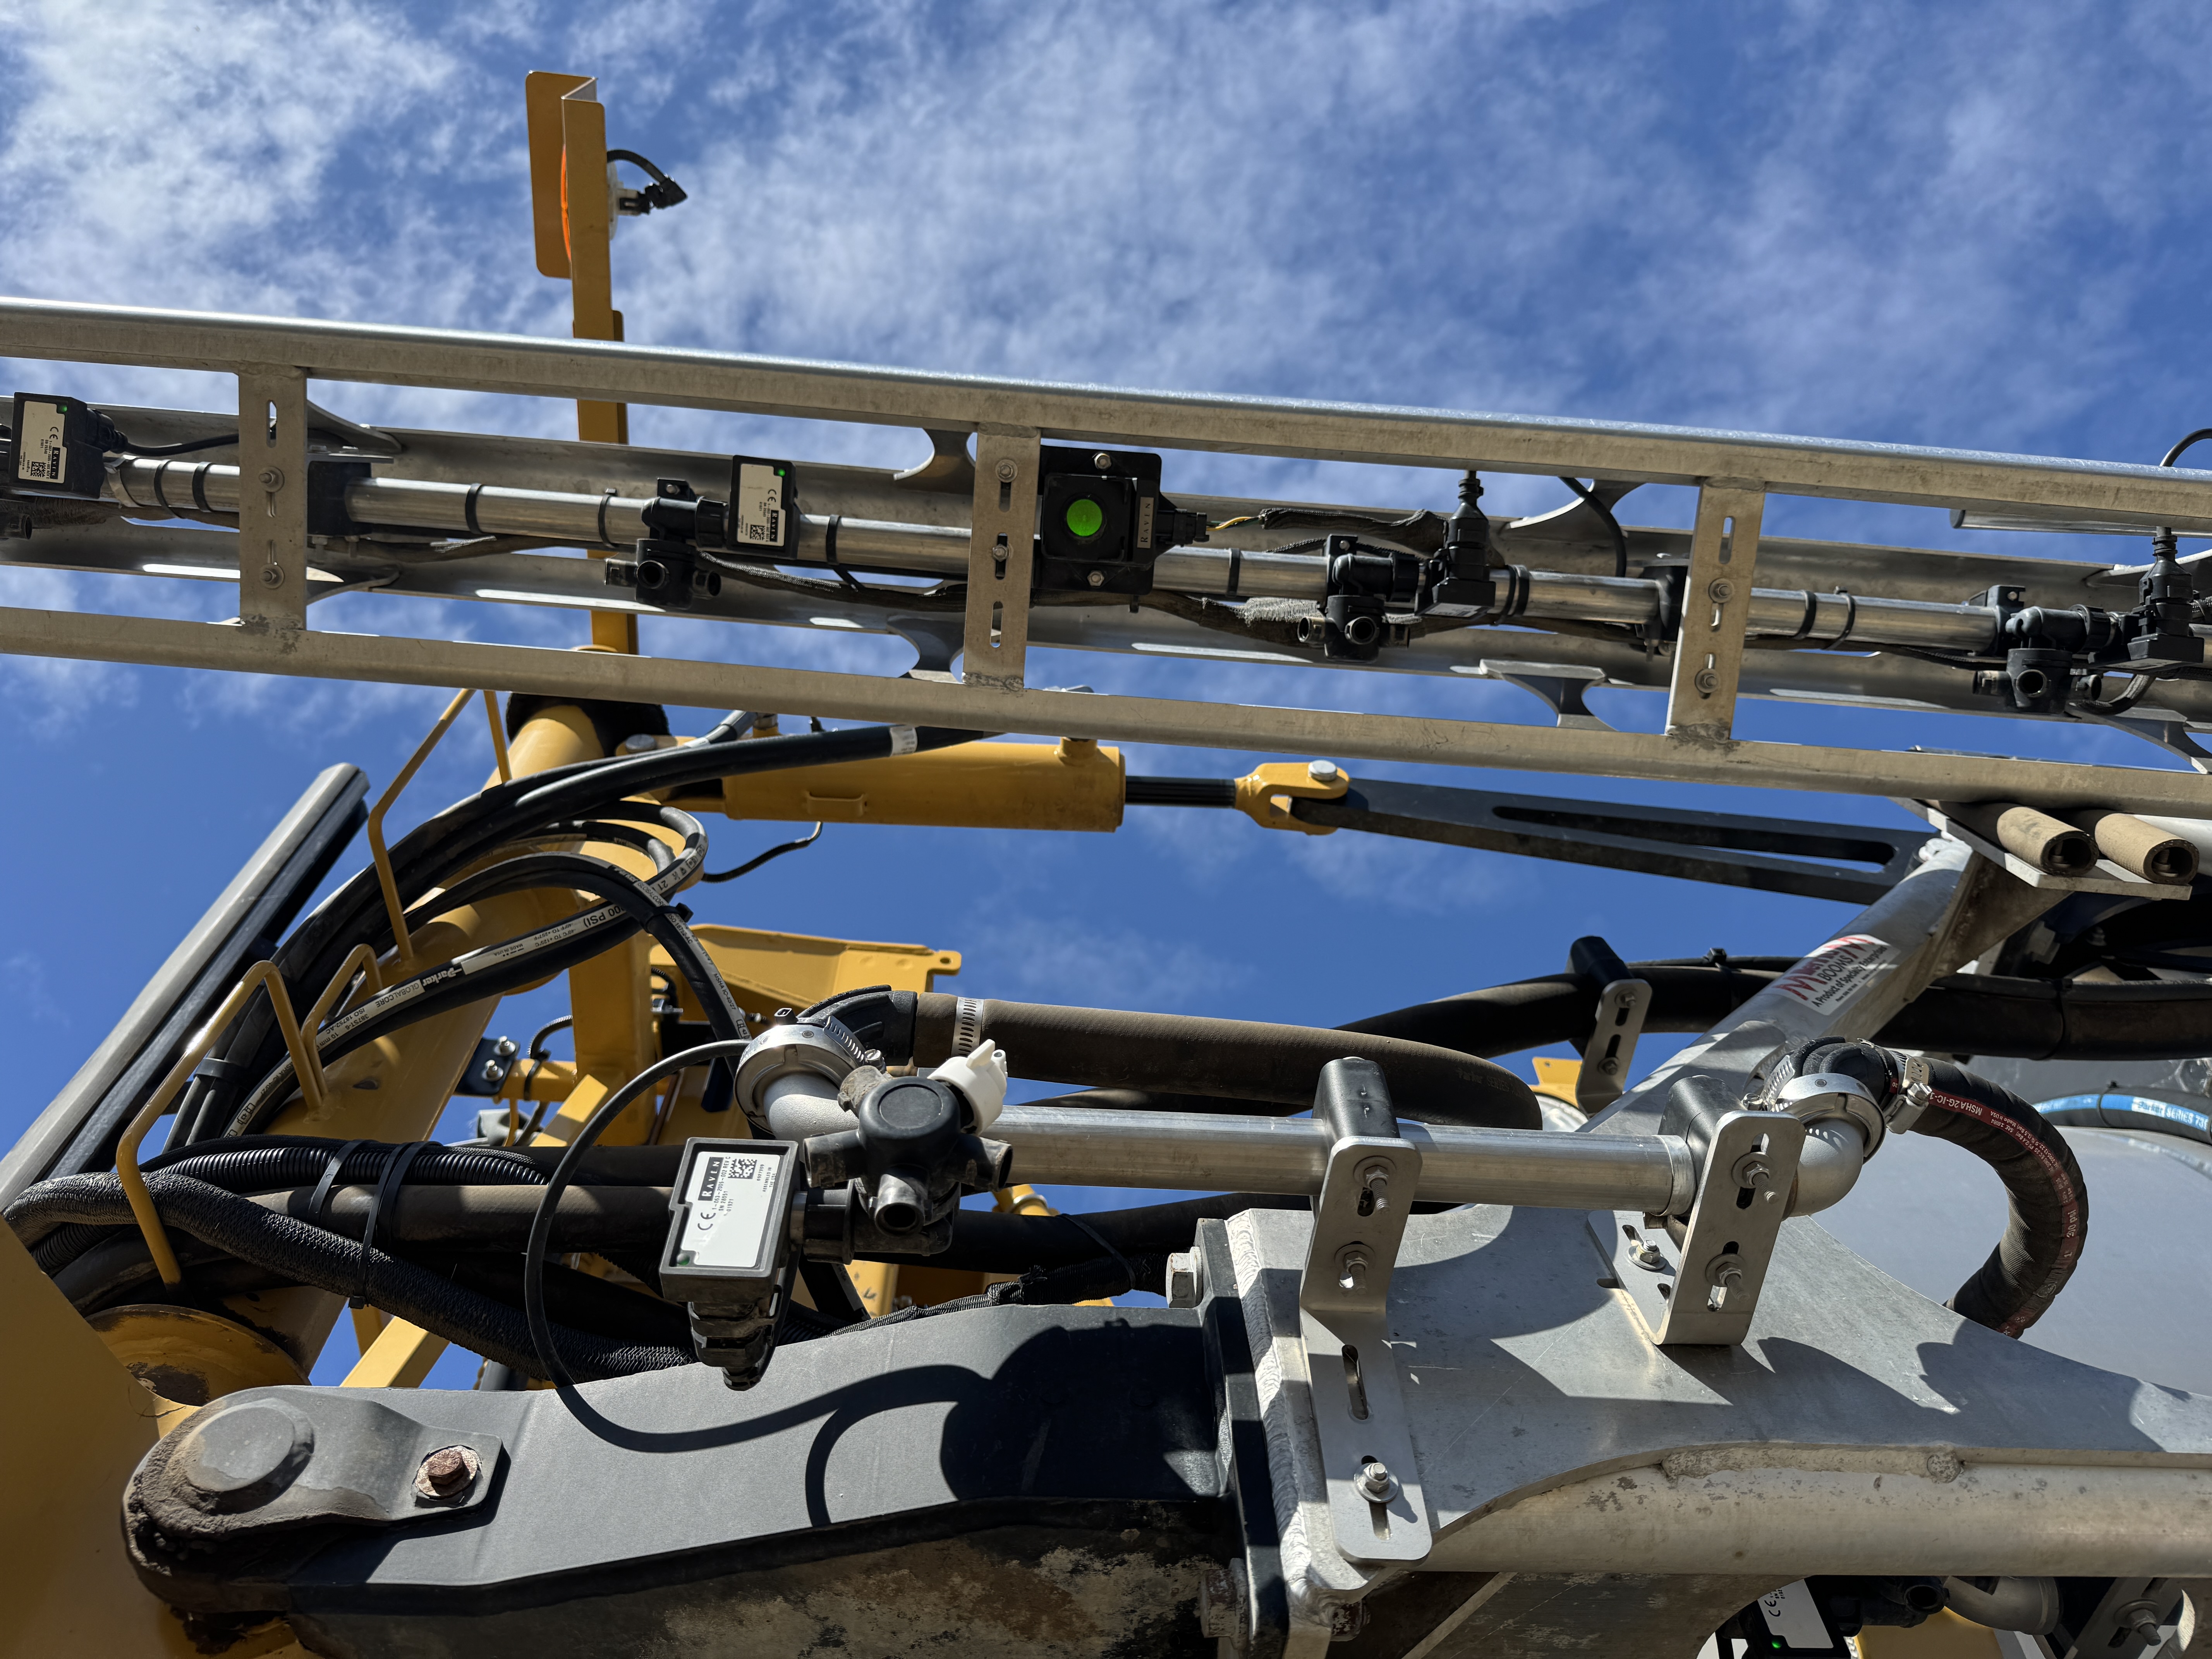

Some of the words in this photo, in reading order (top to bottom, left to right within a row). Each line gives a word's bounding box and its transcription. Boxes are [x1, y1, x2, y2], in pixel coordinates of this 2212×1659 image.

[1140, 503, 1151, 542] RAVEN
[584, 912, 606, 928] PSI)
[422, 967, 462, 986] Parker
[1817, 955, 1854, 981] BOOMS
[375, 982, 419, 1008] GLOBALCORE
[1815, 985, 1839, 1006] Product
[1836, 980, 1845, 990] of
[354, 1008, 365, 1017] ISO
[326, 1016, 353, 1034] 18752-AC
[1961, 1101, 1982, 1116] MSHA
[1990, 1111, 1999, 1119] USA
[2166, 1107, 2194, 1124] SERIES
[702, 1161, 720, 1197] RAVEN
[697, 1212, 716, 1231] CE
[2068, 1210, 2078, 1223] psi
[1764, 1600, 1781, 1617] CE
